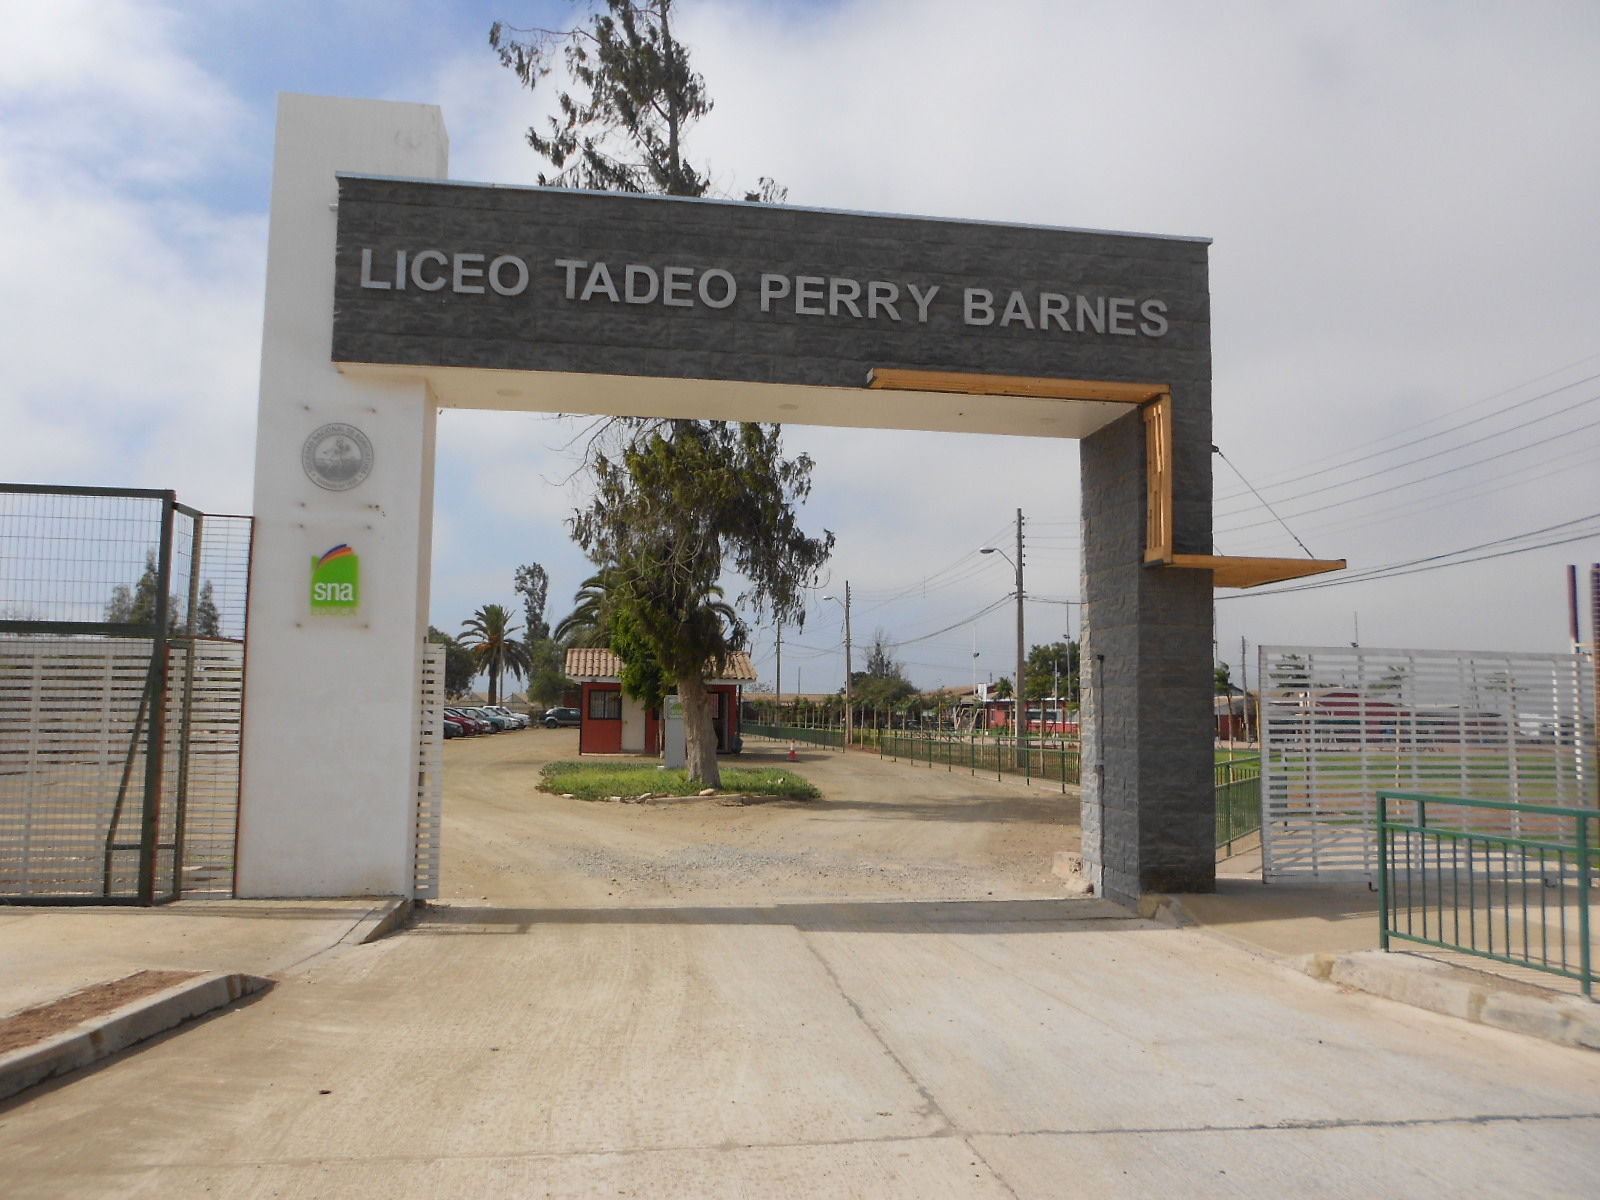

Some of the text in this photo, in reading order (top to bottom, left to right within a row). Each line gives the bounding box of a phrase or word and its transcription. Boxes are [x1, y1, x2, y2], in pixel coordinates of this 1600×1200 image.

[361, 249, 1169, 337] LICEO TADEO PERRY BARNES
[314, 582, 354, 601] sna
